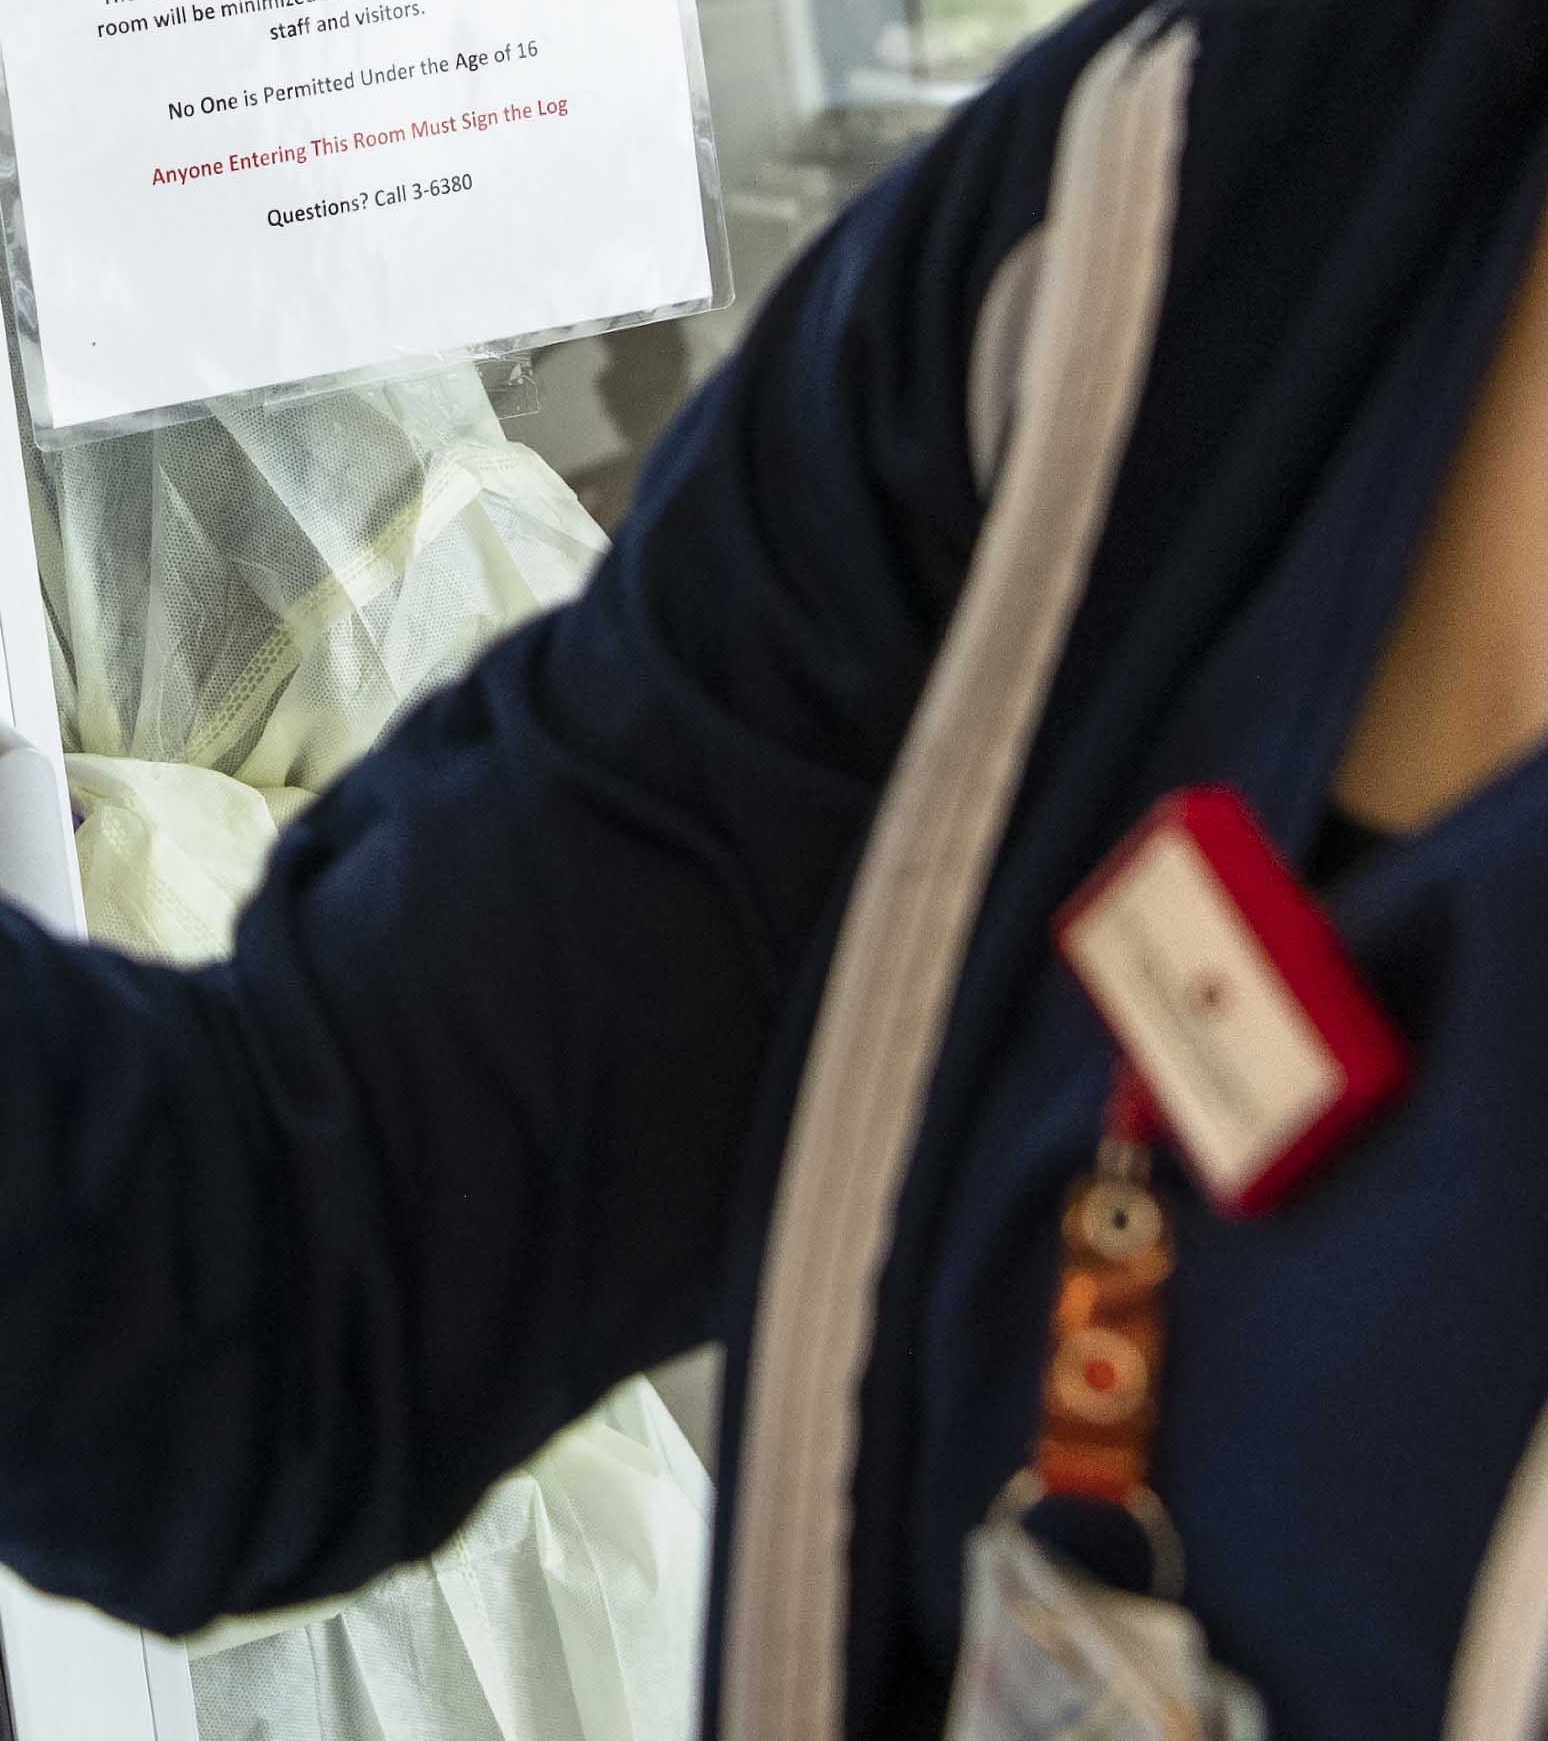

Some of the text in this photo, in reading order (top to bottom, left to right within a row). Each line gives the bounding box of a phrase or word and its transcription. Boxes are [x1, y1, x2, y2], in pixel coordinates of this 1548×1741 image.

[97, 17, 149, 38] room
[153, 5, 187, 28] will
[191, 4, 216, 22] be
[269, 3, 425, 41] staff and visitors.
[168, 40, 538, 120] No One is Permitted Under the Age of 16
[152, 99, 569, 186] Anyone Entering This Room Must Sign the Log
[267, 173, 473, 228] Questions? Call 3-6380
